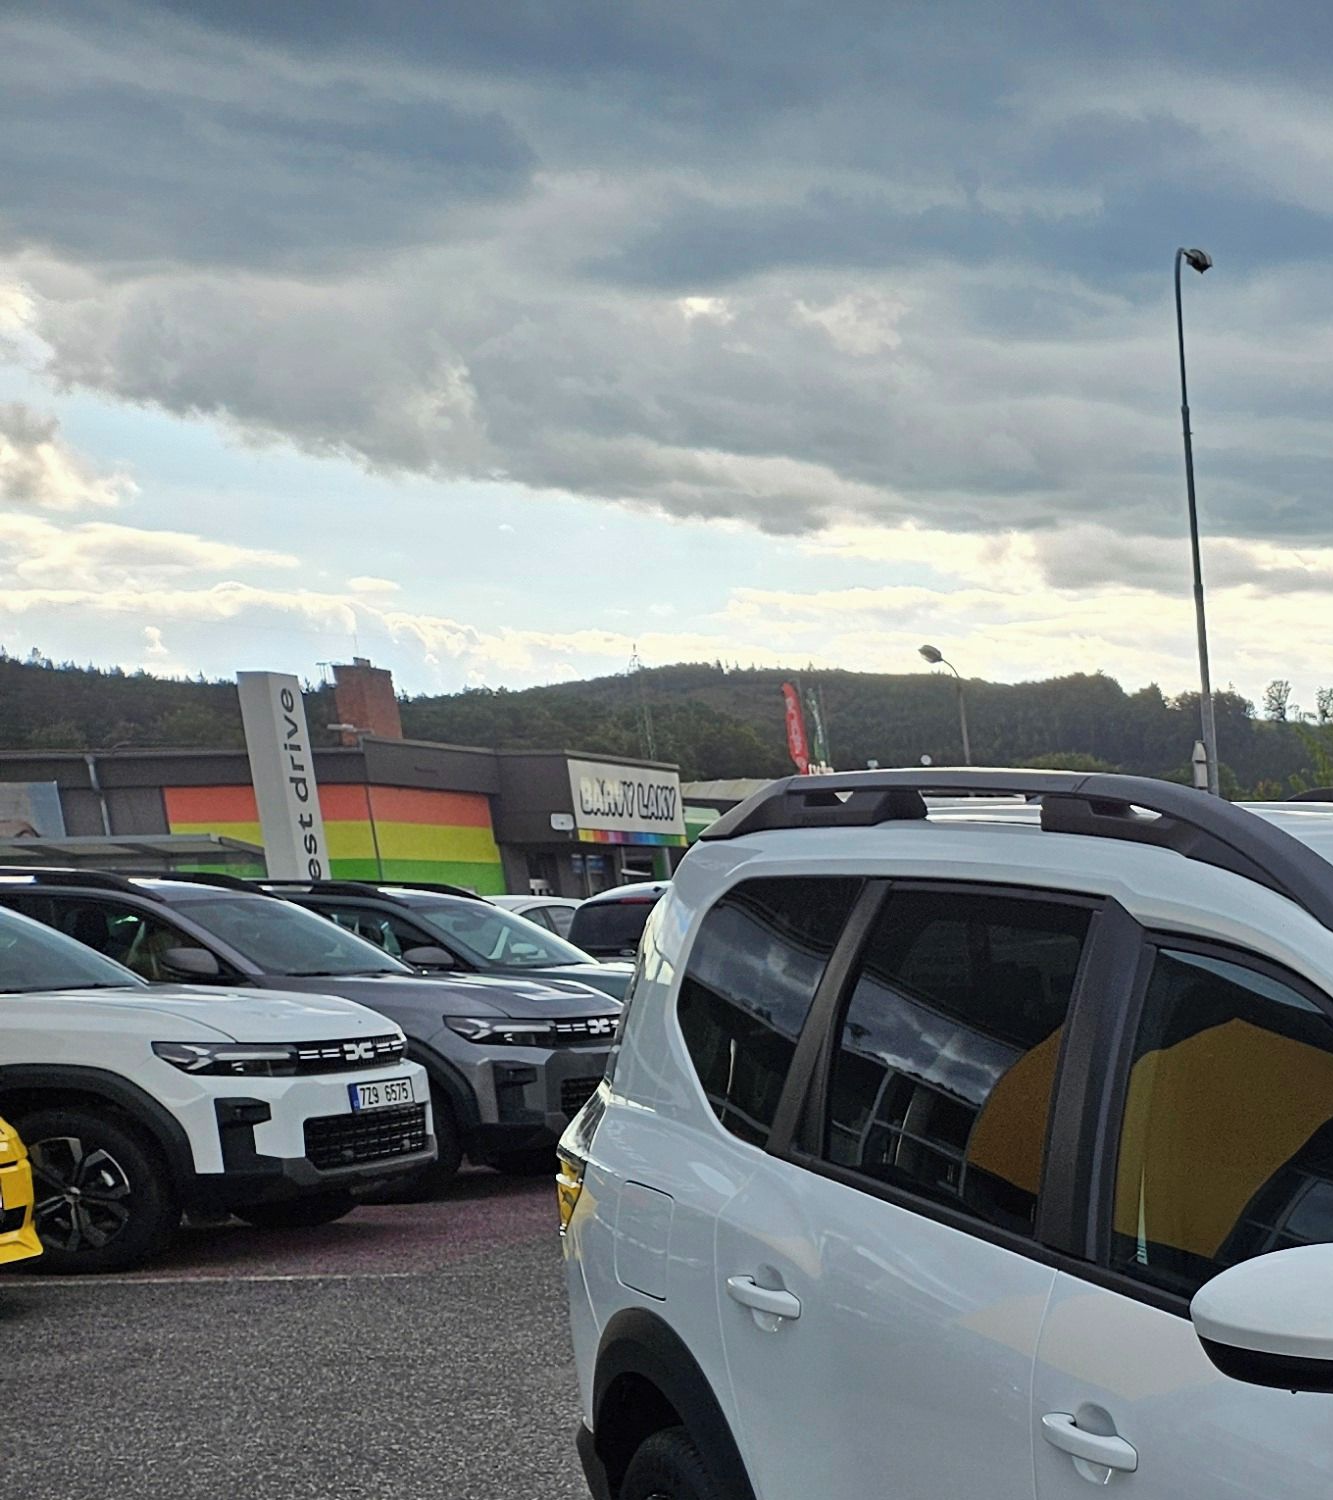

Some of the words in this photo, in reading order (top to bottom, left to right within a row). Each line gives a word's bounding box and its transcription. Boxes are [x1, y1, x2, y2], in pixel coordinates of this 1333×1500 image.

[281, 687, 309, 802] drive
[580, 777, 635, 818] BARVY
[637, 782, 676, 821] LAKY
[298, 812, 322, 880] est
[360, 1086, 379, 1106] 7Z9
[385, 1081, 408, 1102] 6575
